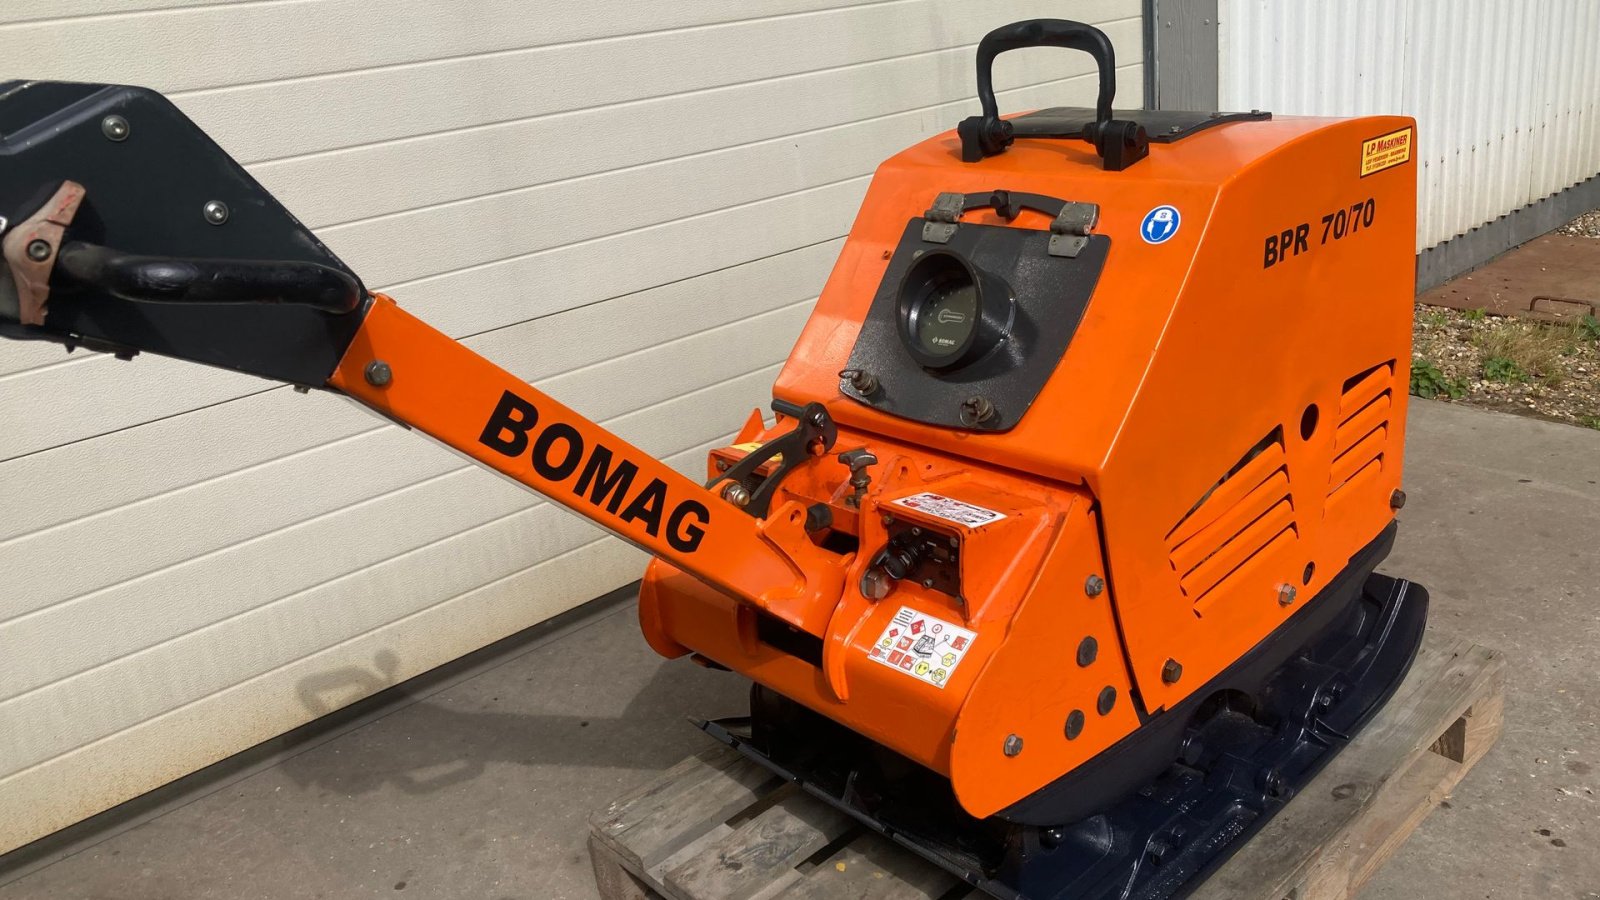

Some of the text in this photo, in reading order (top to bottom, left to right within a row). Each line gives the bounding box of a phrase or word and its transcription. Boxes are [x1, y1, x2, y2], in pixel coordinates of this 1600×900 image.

[1366, 134, 1408, 156] LP MASKINER
[1263, 197, 1376, 270] BPR 70/70
[478, 389, 710, 554] BOMAG
